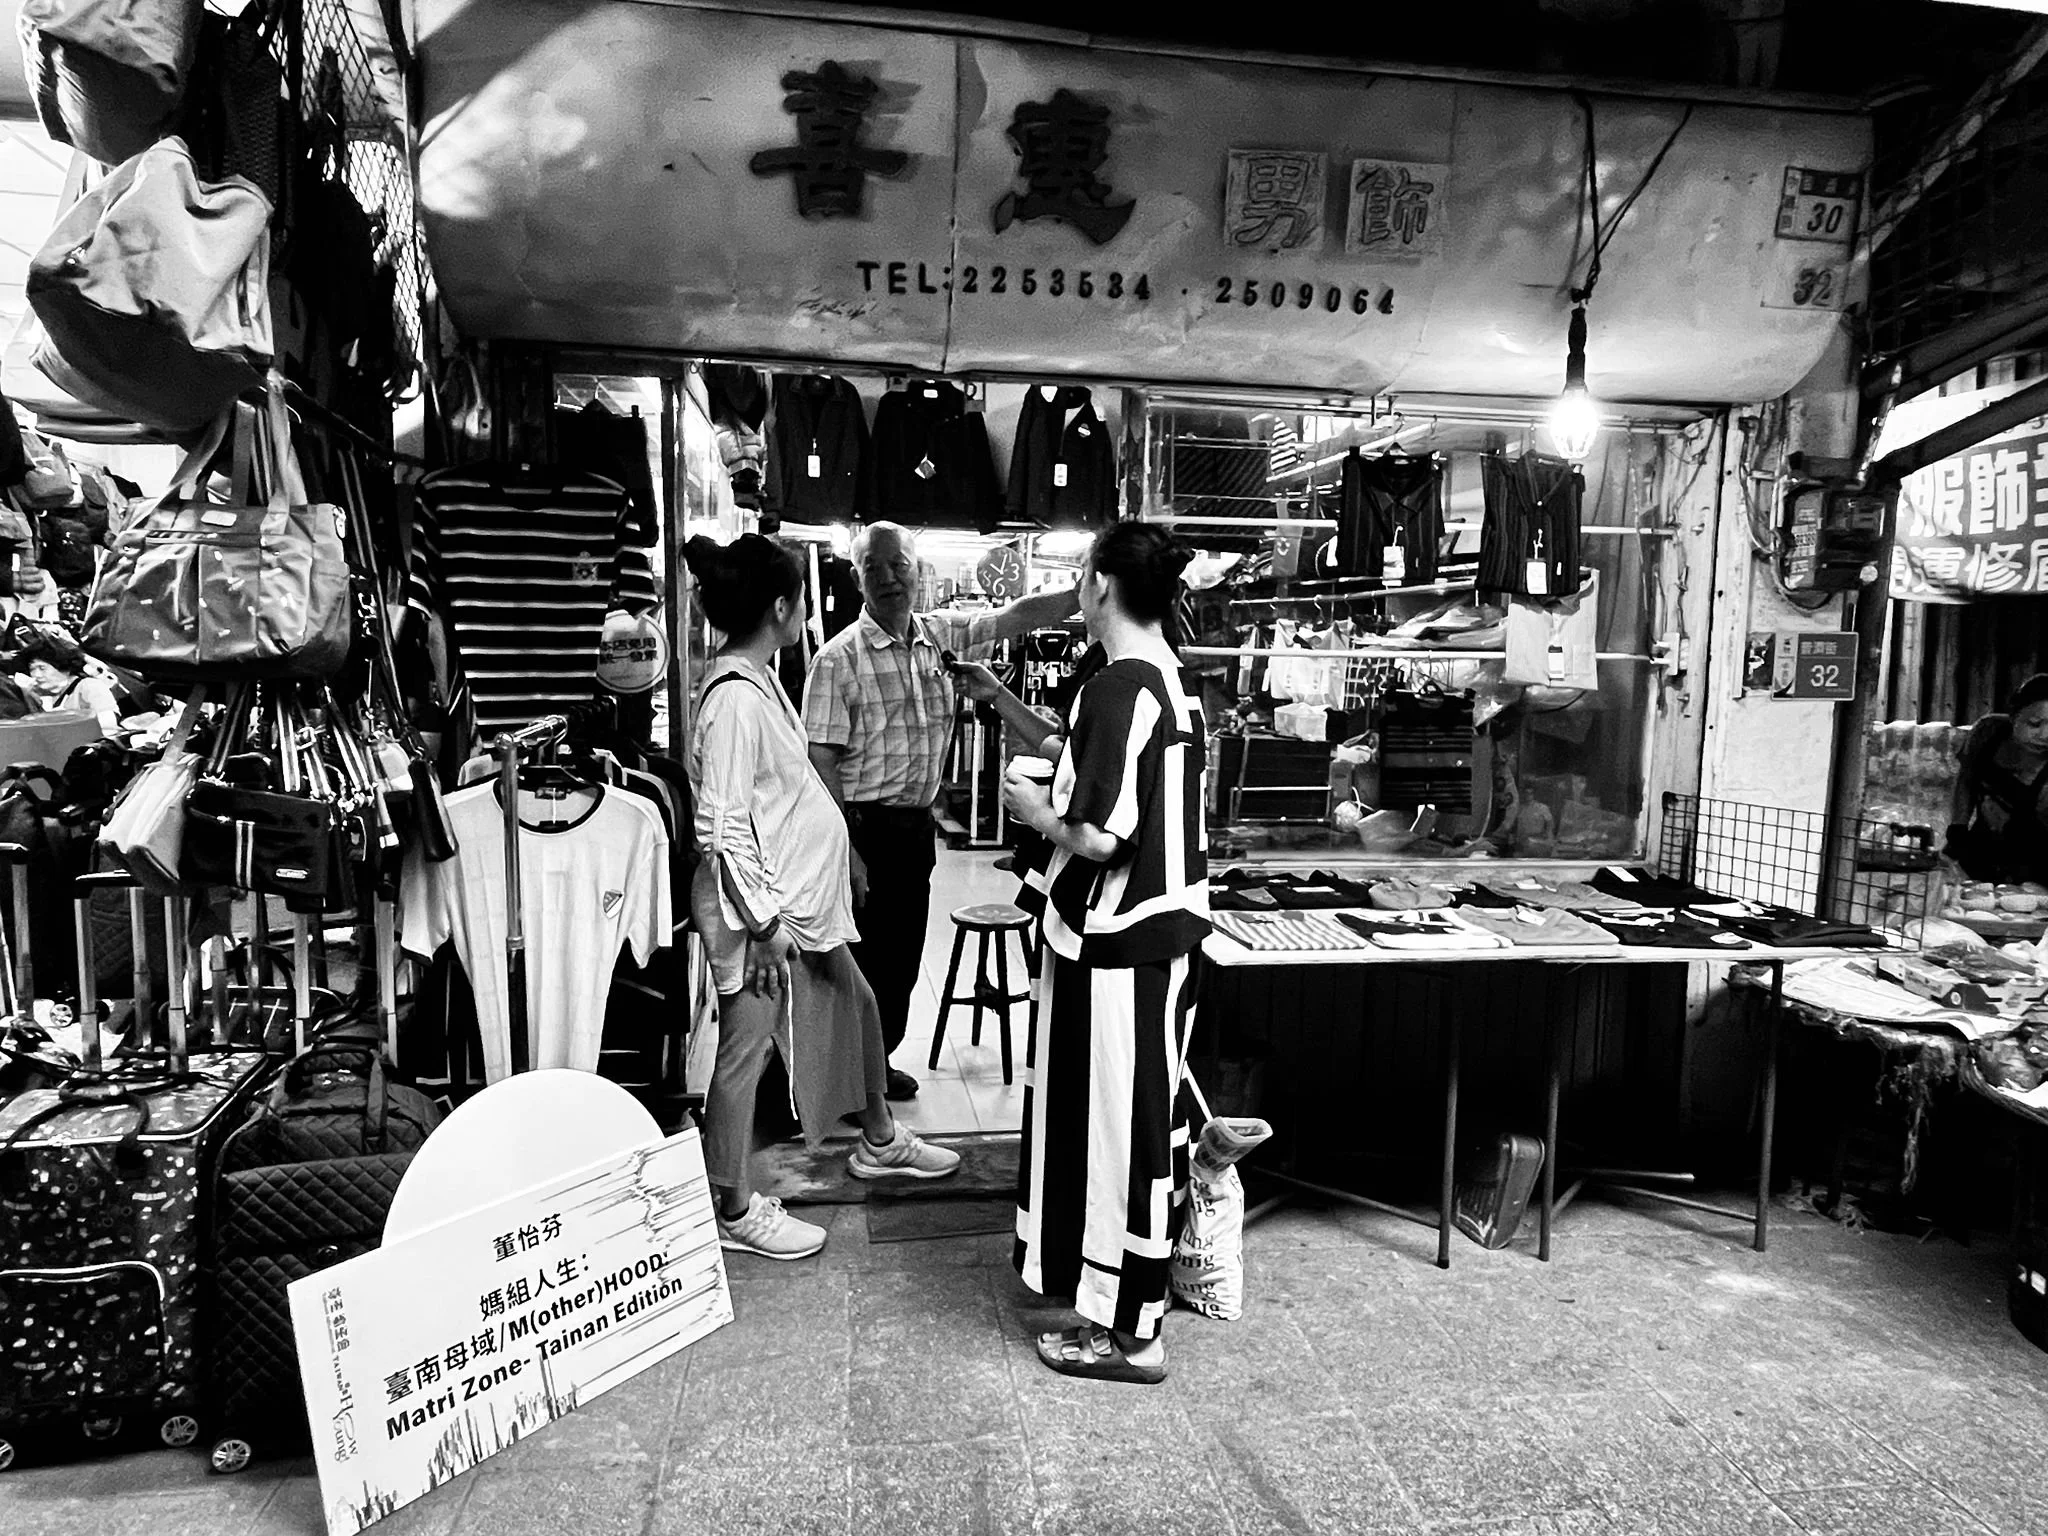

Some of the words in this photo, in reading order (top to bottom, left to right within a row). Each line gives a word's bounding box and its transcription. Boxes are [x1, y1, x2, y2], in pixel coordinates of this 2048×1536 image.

[1807, 202, 1844, 234] 30
[1215, 276, 1395, 315] 2509064
[1909, 441, 2048, 538] 服飾
[1810, 664, 1839, 687] 32
[493, 1213, 563, 1262] 董怡芬
[386, 1386, 456, 1440] Matri
[461, 1358, 531, 1402] Zone-
[535, 1314, 609, 1360] Tainan
[613, 1277, 683, 1322] Edition
